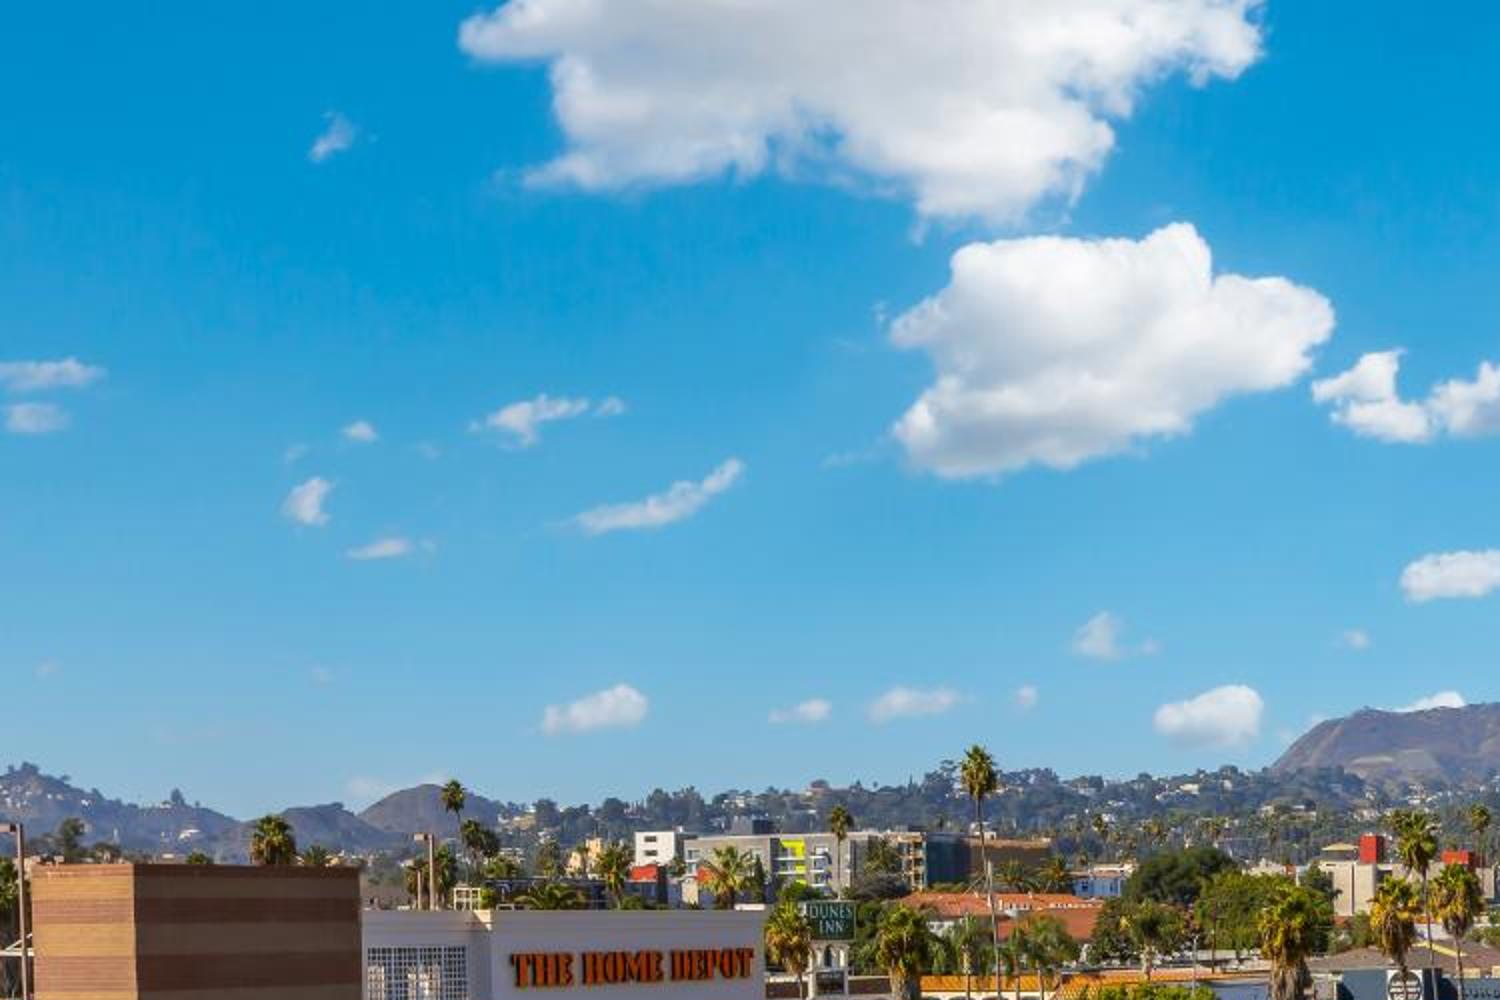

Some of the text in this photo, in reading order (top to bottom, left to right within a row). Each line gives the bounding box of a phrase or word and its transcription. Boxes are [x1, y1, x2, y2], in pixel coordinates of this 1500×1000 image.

[810, 904, 852, 919] DUNES
[820, 920, 843, 934] INN
[510, 948, 754, 987] THE HOME DEPOT
